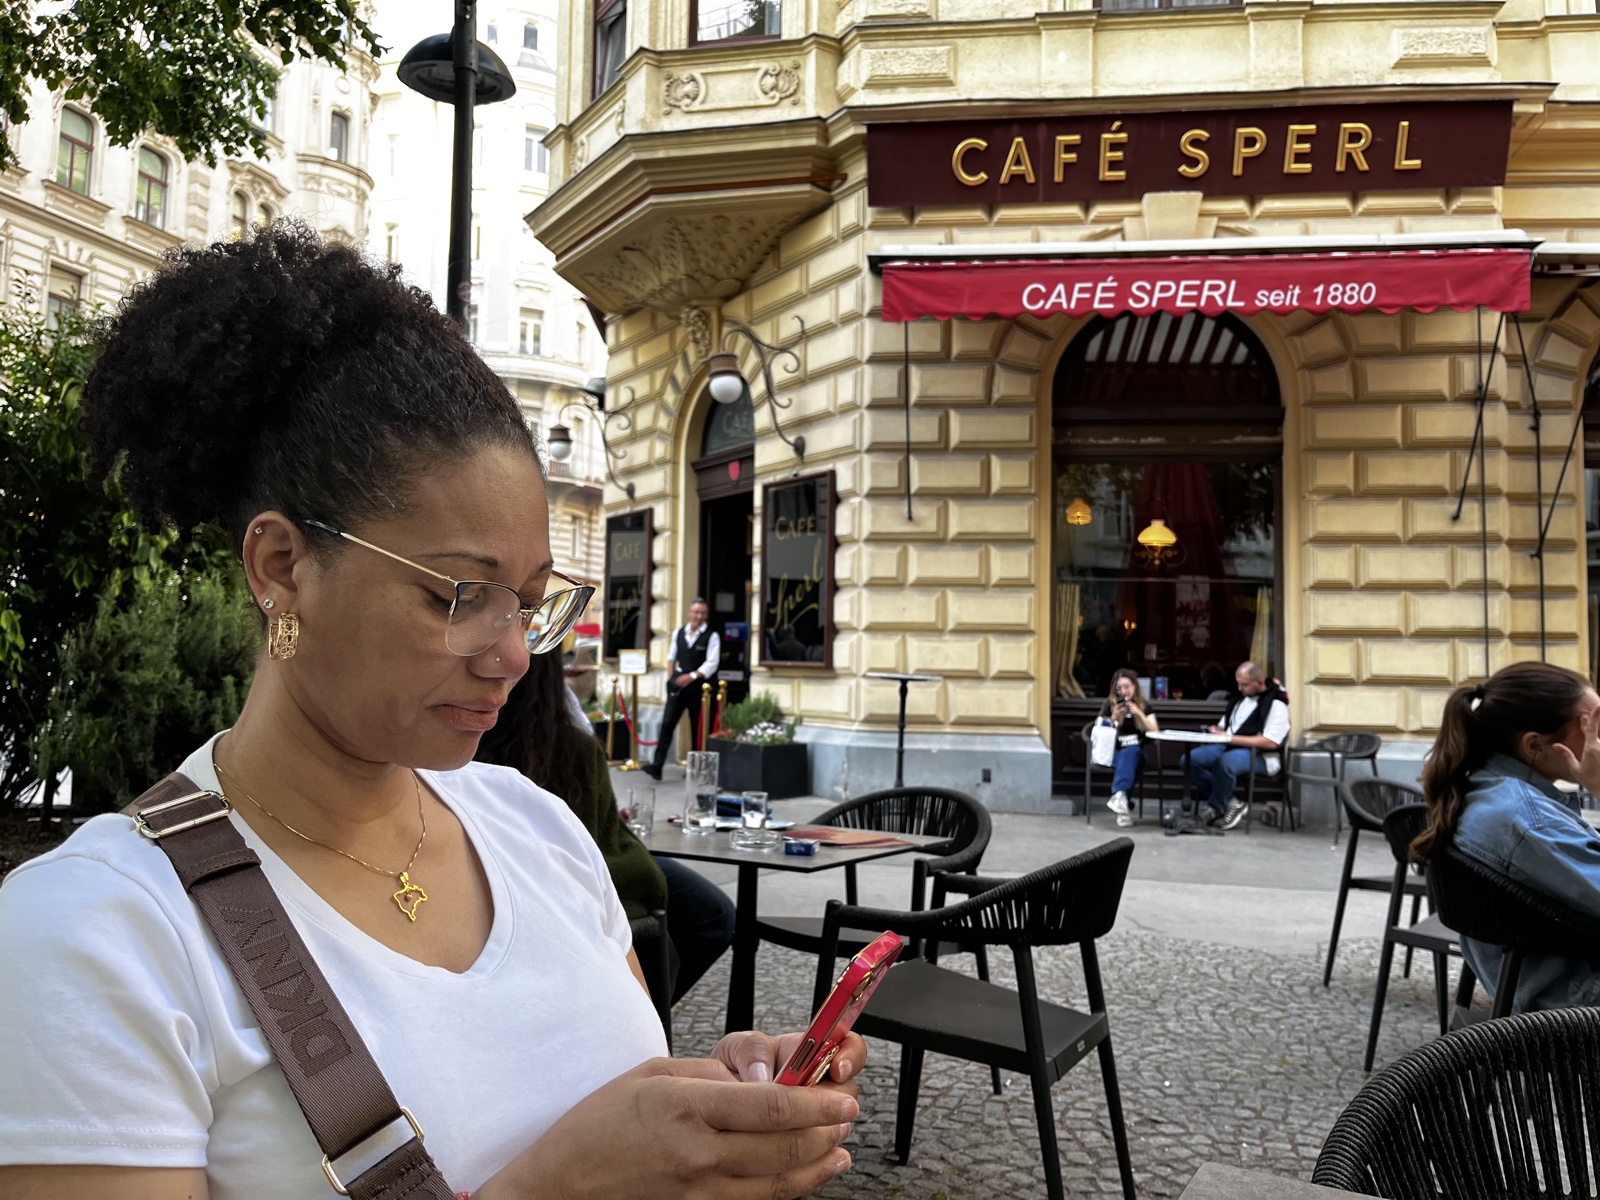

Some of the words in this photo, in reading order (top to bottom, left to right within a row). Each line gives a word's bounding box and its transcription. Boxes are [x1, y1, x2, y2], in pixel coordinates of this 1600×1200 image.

[952, 120, 1128, 186] CAFÉ
[1177, 121, 1422, 178] SPERL
[1022, 275, 1118, 310] CAFÉ
[1128, 279, 1245, 308] SPERL
[1254, 284, 1301, 307] seit
[1313, 282, 1376, 306] 1880
[722, 411, 750, 434] CAF
[775, 514, 816, 540] CAFÉ
[219, 905, 351, 1078] DKNY
